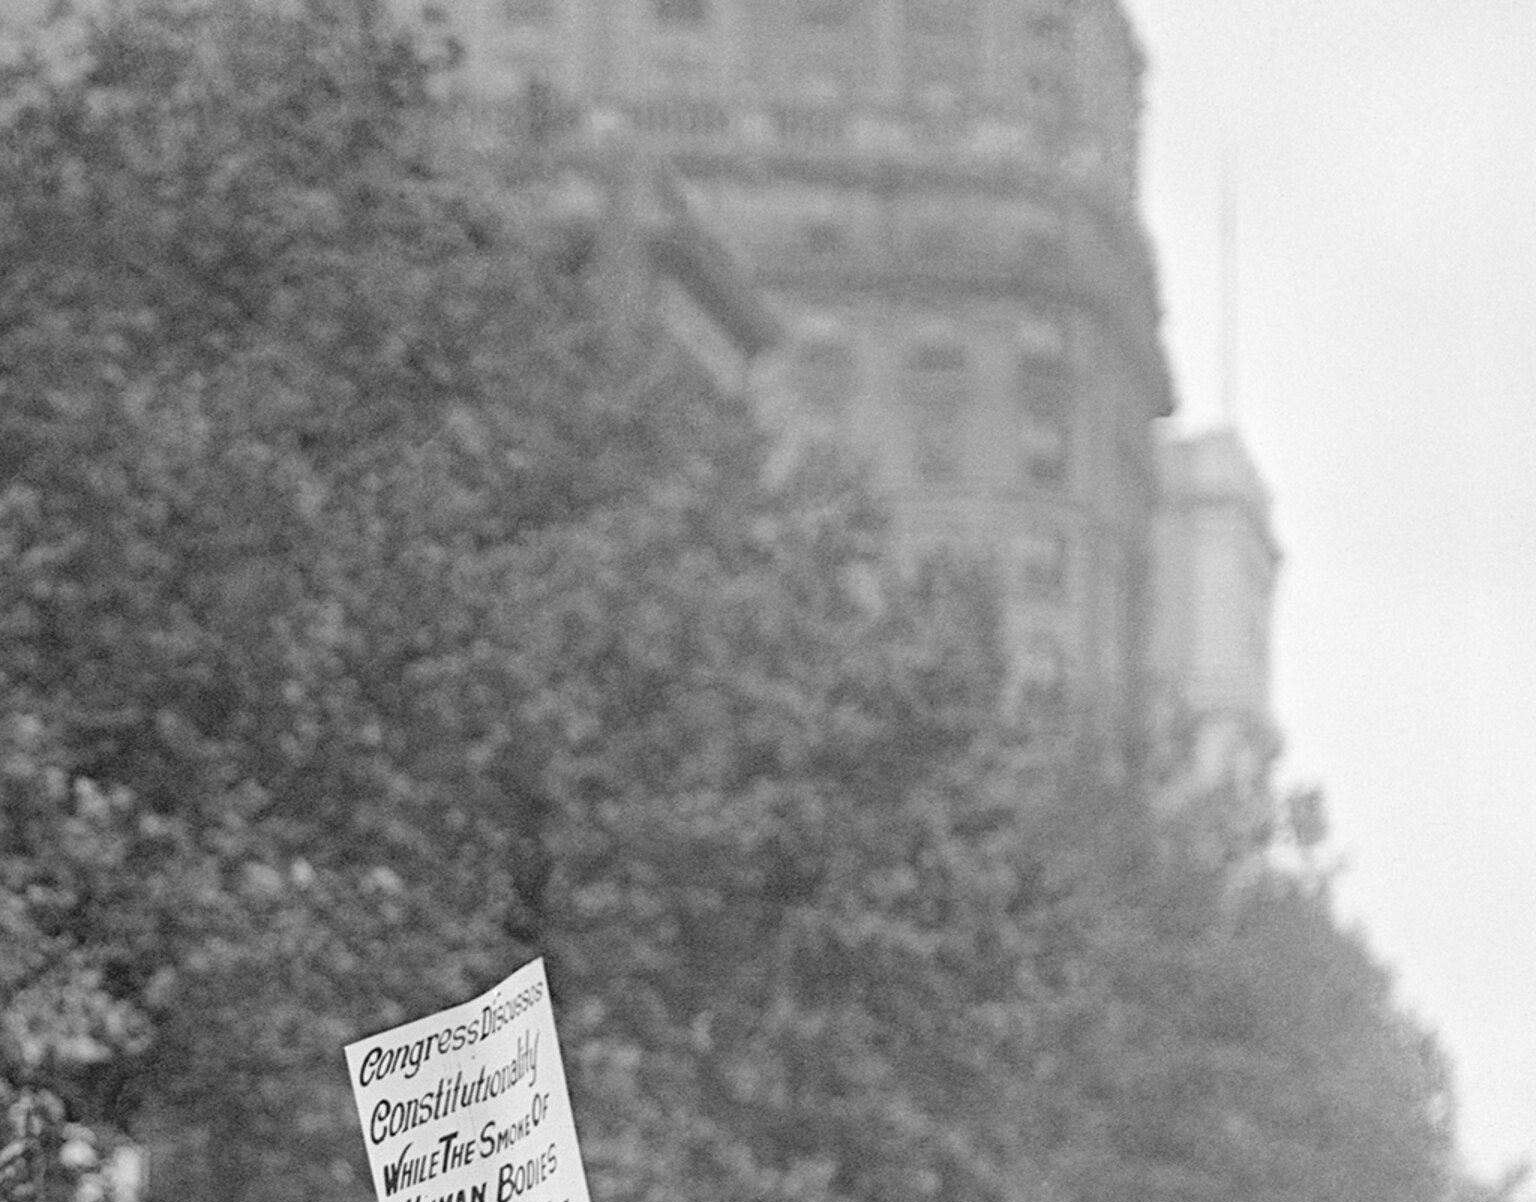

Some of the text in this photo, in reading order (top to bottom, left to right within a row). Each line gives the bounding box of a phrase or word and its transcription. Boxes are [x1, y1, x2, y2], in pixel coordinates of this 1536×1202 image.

[359, 1019, 479, 1087] Congress
[370, 1028, 541, 1145] Constitutionality
[383, 1092, 550, 1198] WHILE THE SMOKE OF
